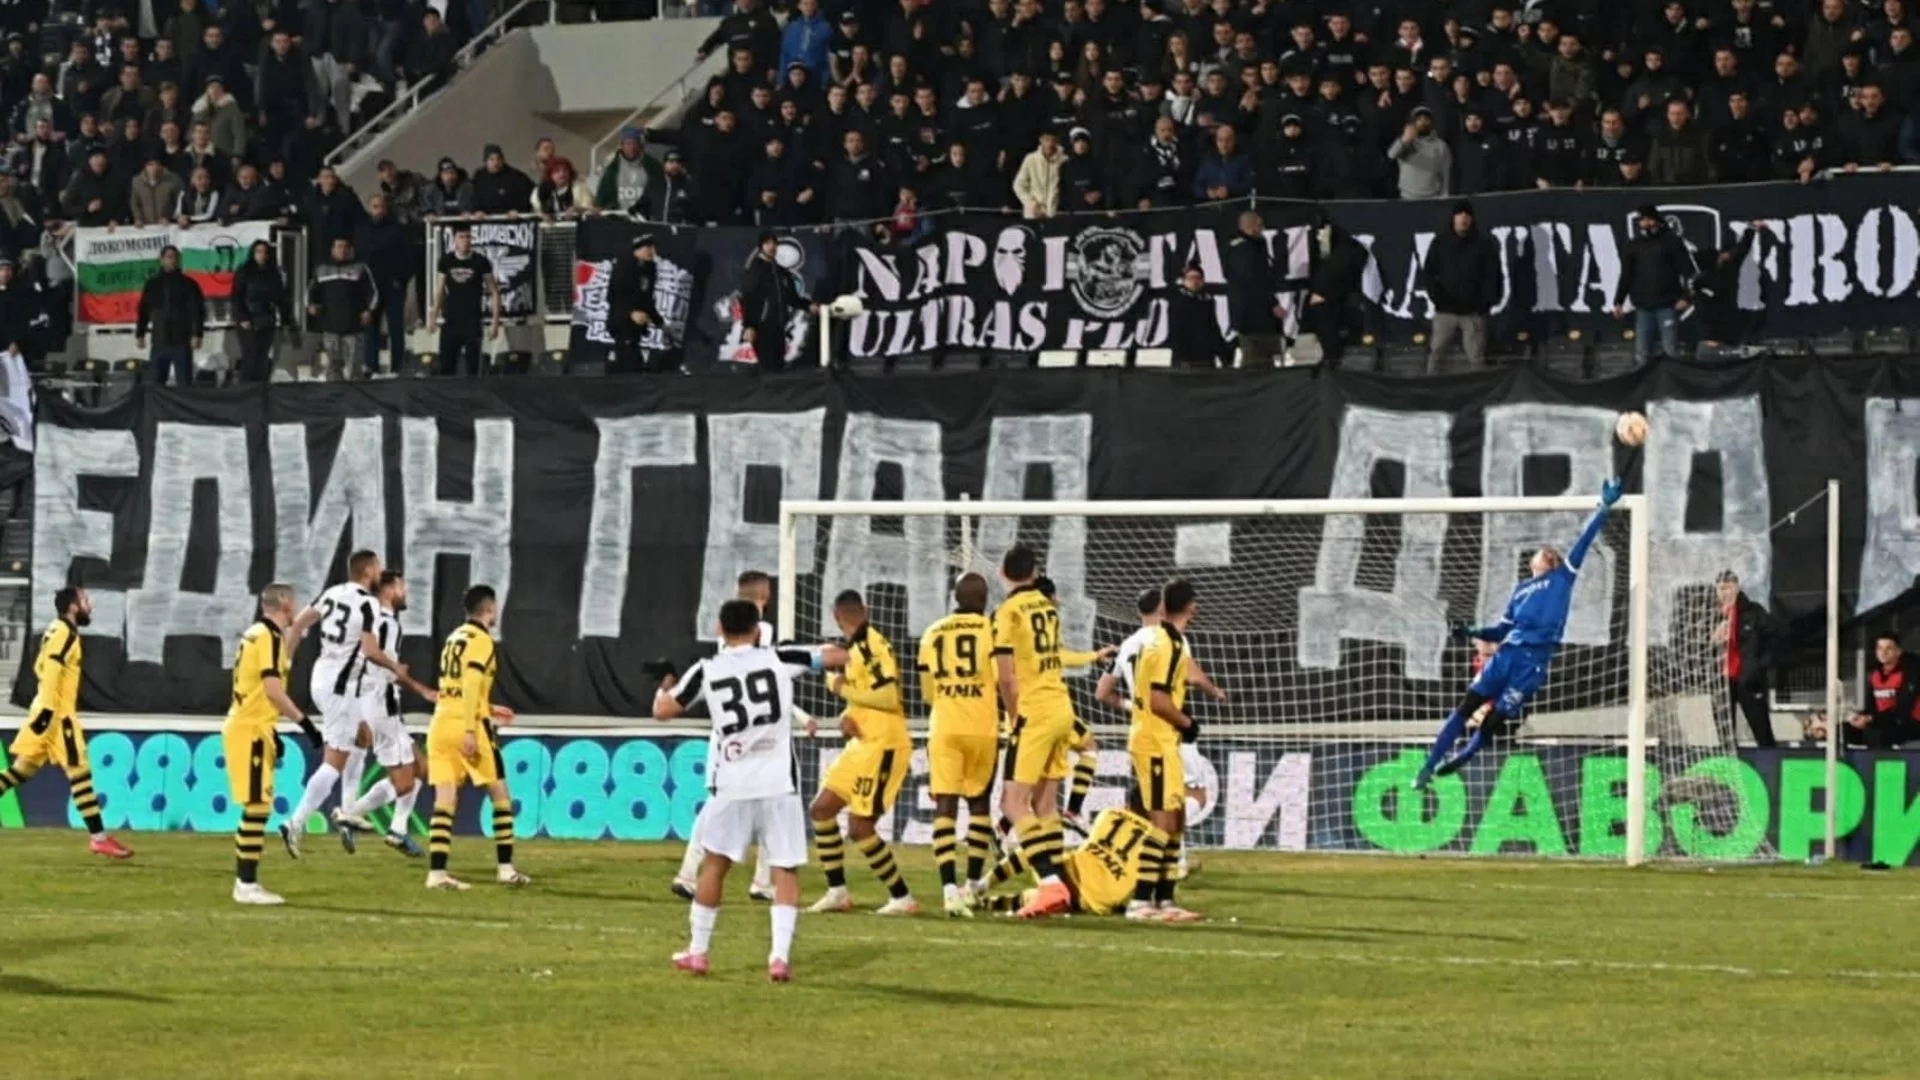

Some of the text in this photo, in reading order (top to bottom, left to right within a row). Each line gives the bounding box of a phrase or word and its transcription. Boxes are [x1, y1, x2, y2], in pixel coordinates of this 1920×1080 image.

[1728, 204, 1920, 311] FRO
[850, 295, 1048, 357] ULTRAS
[31, 415, 514, 669] ЕДИН
[579, 407, 1096, 676] ГРАД
[1299, 394, 1773, 682] ДВА
[320, 598, 351, 645] 23
[1030, 609, 1060, 654] 87
[932, 634, 977, 679] 19
[710, 667, 782, 737] 39
[1098, 818, 1145, 862] 11
